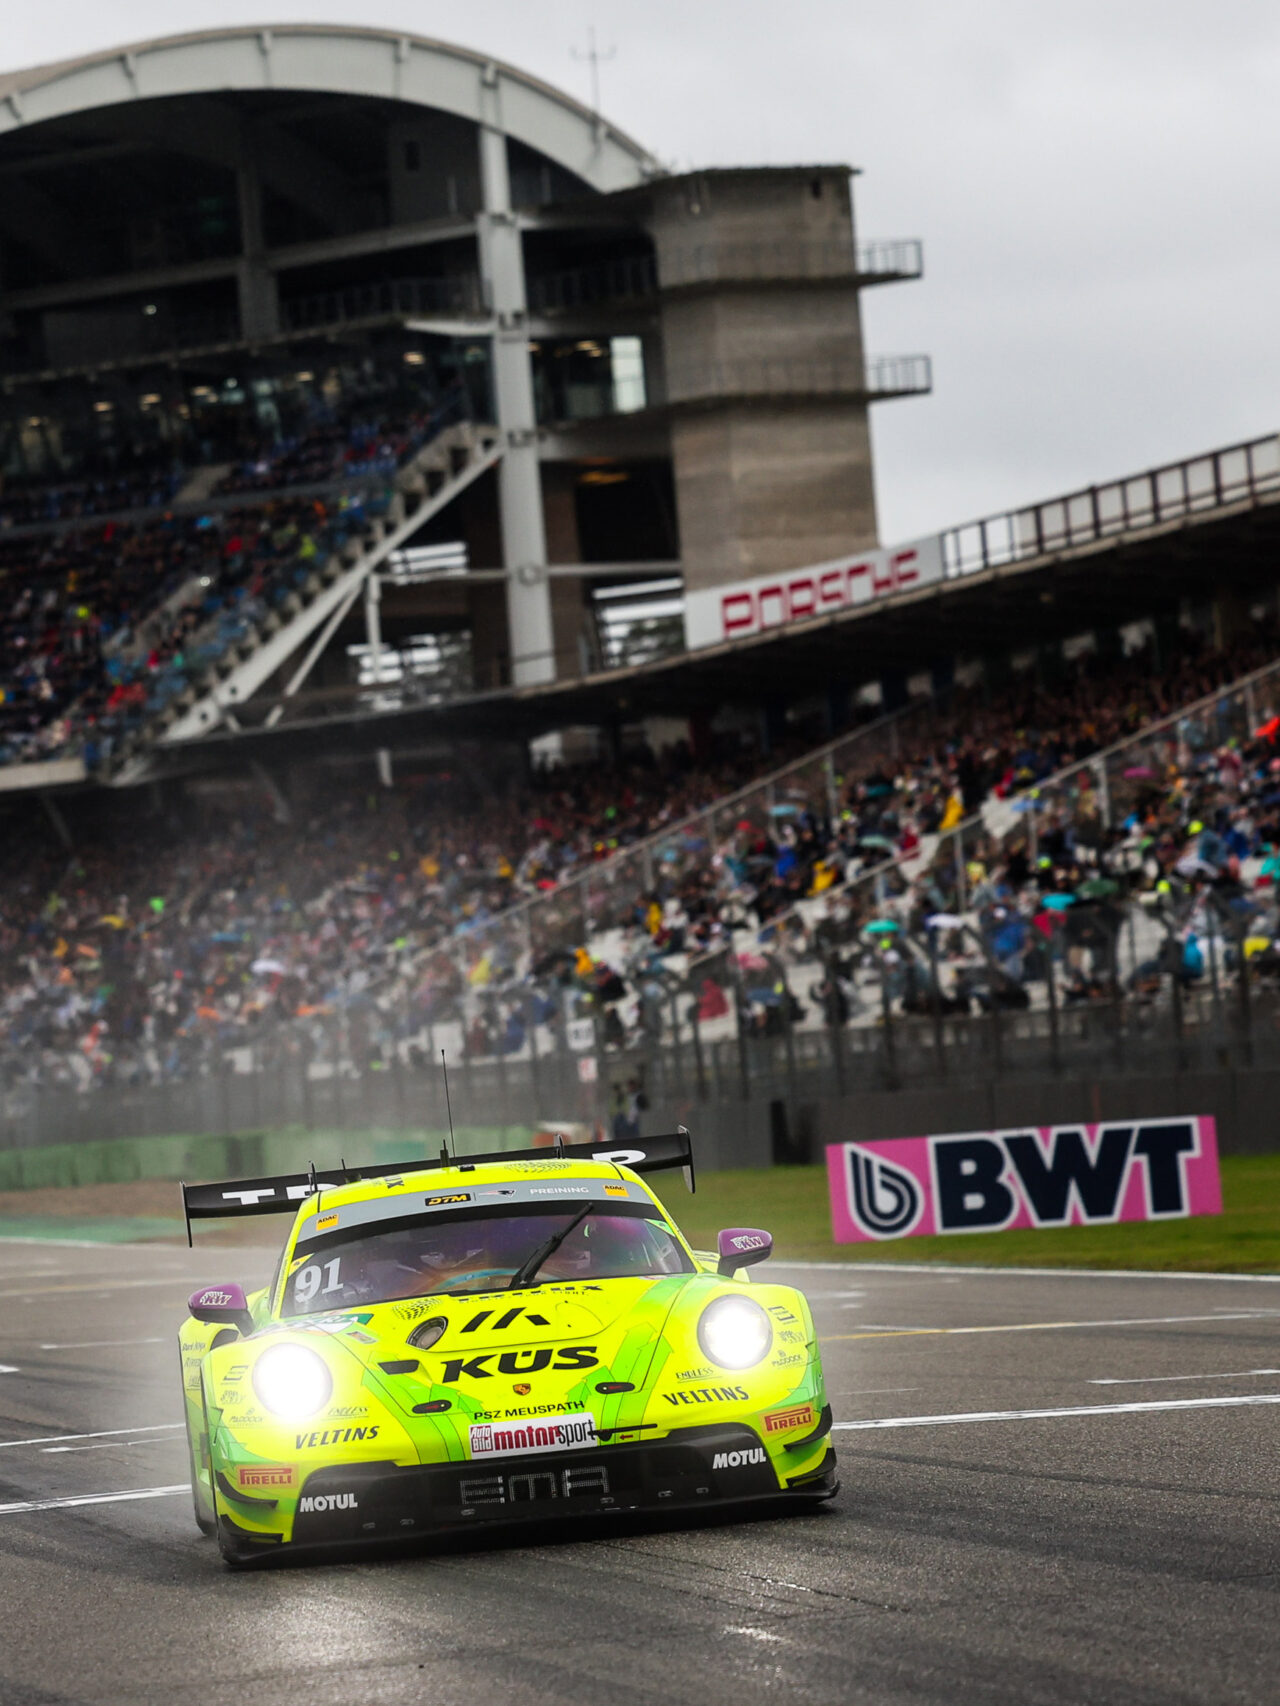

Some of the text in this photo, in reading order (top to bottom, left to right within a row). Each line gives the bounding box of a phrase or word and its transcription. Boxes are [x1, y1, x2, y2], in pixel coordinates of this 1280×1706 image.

[721, 549, 918, 639] PORSCHE
[930, 1119, 1198, 1232] BWT
[428, 1194, 468, 1206] DTM
[529, 1186, 589, 1195] PREINING
[317, 1214, 338, 1224] ADAC
[294, 1257, 344, 1303] 91
[440, 1346, 599, 1384] KÜS
[676, 1368, 714, 1380] ENDLESS
[662, 1386, 750, 1406] VELTINS
[474, 1401, 585, 1420] PSZ MEUSPATH
[764, 1407, 812, 1431] PIRELLI
[295, 1425, 379, 1449] VELTINS
[494, 1419, 596, 1450] motorsport
[713, 1447, 766, 1469] MOTUL
[239, 1468, 292, 1485] PIRELLI
[300, 1493, 358, 1512] MOTUL
